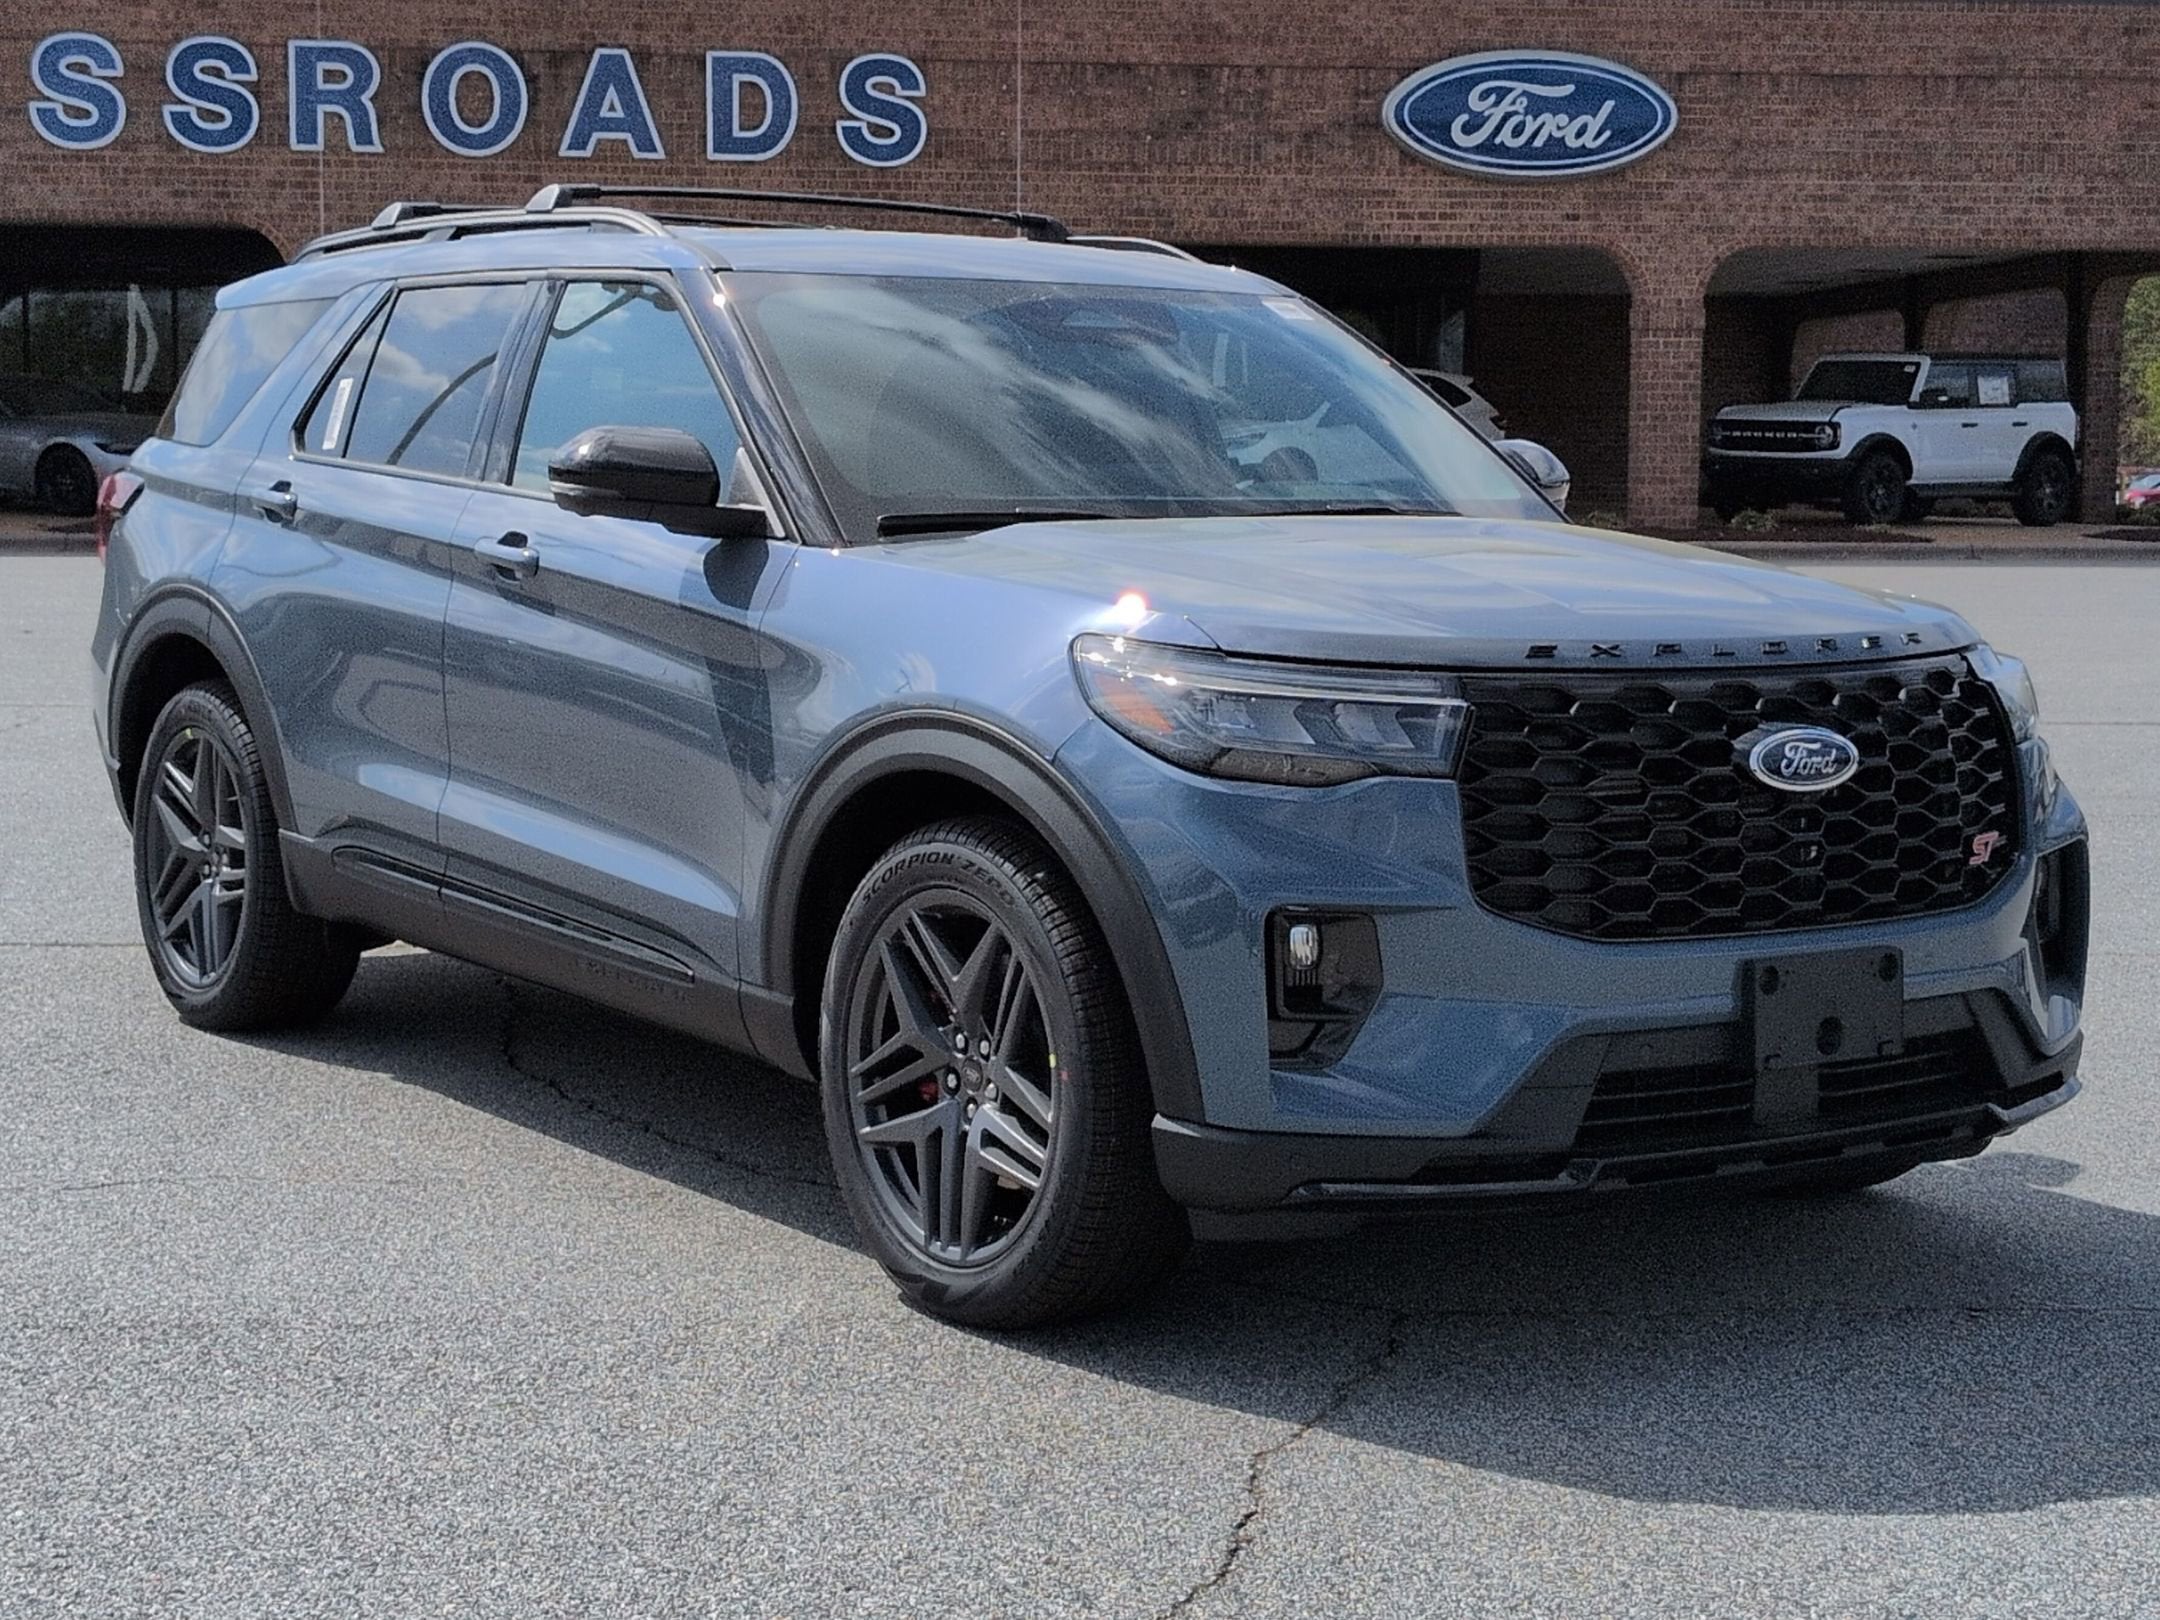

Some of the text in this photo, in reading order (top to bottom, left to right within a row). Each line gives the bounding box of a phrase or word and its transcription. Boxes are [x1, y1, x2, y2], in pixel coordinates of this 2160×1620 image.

[1450, 79, 1616, 149] Ford
[1525, 632, 1922, 659] EXPLORER
[1781, 741, 1838, 777] Ford
[1969, 830, 2000, 865] ST
[862, 851, 1016, 905] SCORPION ZERO
